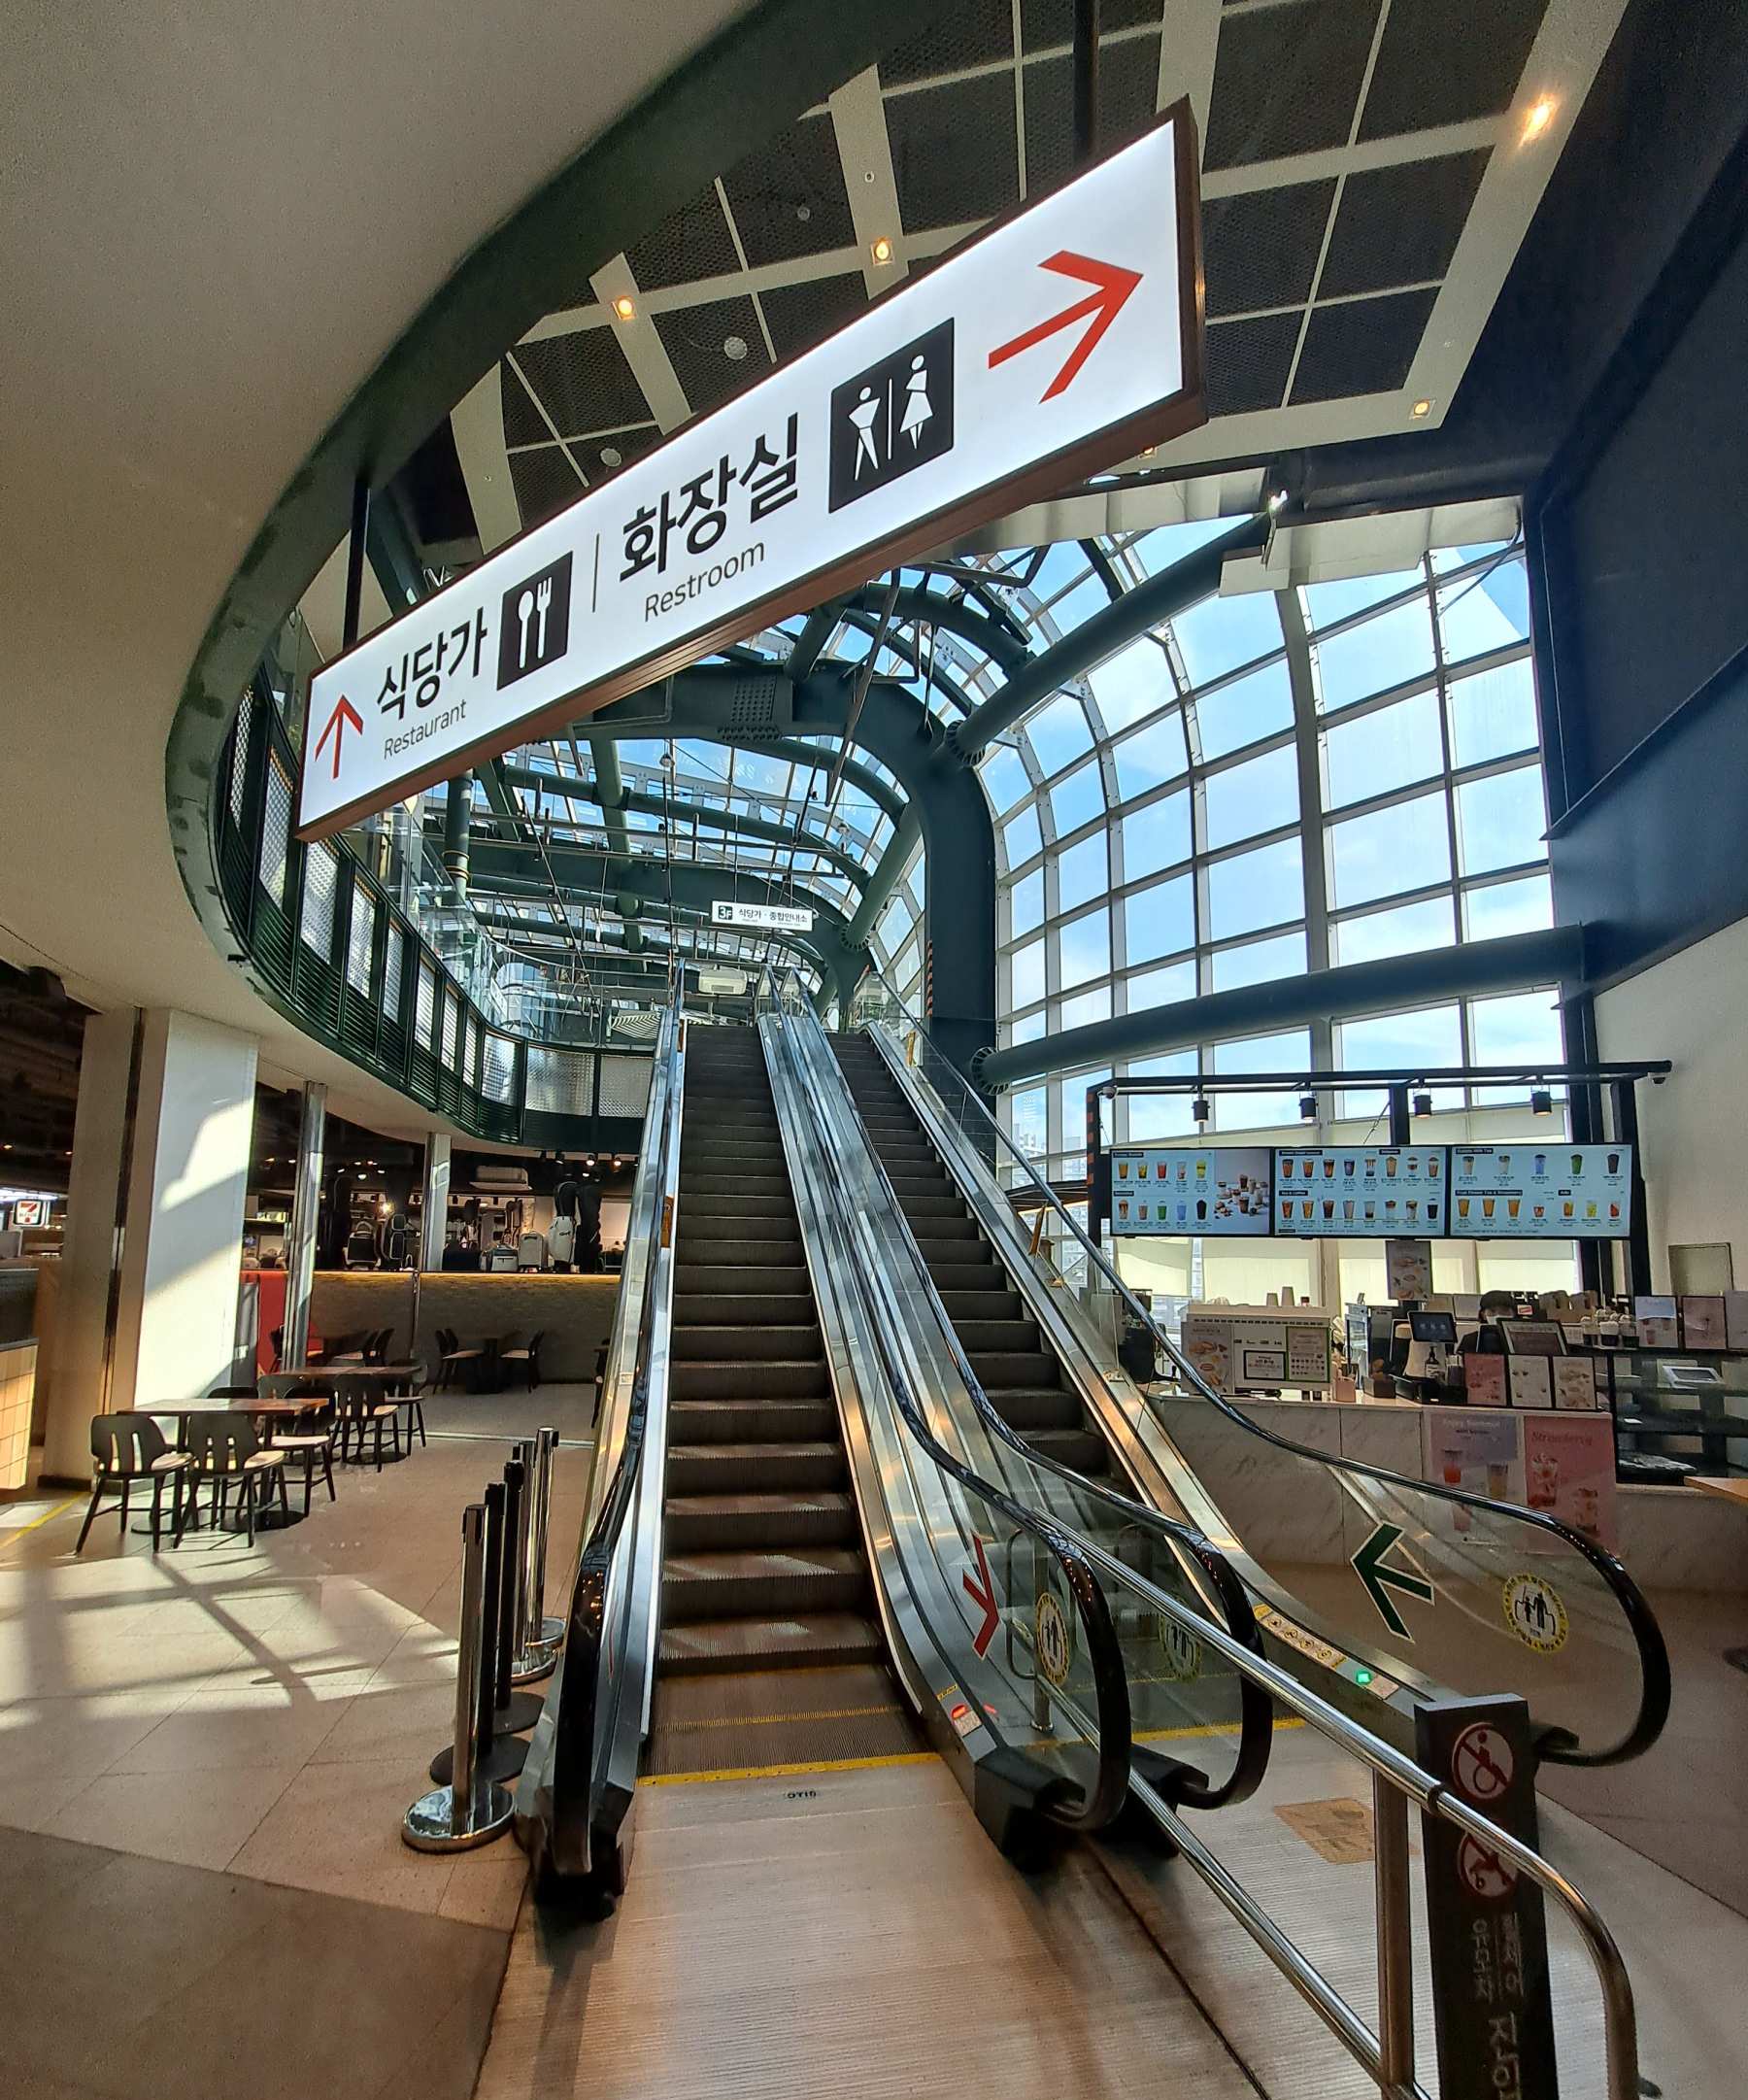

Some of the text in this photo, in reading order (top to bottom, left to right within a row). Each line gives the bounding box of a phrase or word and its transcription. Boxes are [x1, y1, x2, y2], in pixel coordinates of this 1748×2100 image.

[620, 412, 798, 582] 화장실
[645, 541, 766, 623] Restroom
[377, 607, 487, 722] 식당가
[384, 698, 467, 761] Restaurant
[719, 906, 807, 923] 3F 식당가 종합안내소
